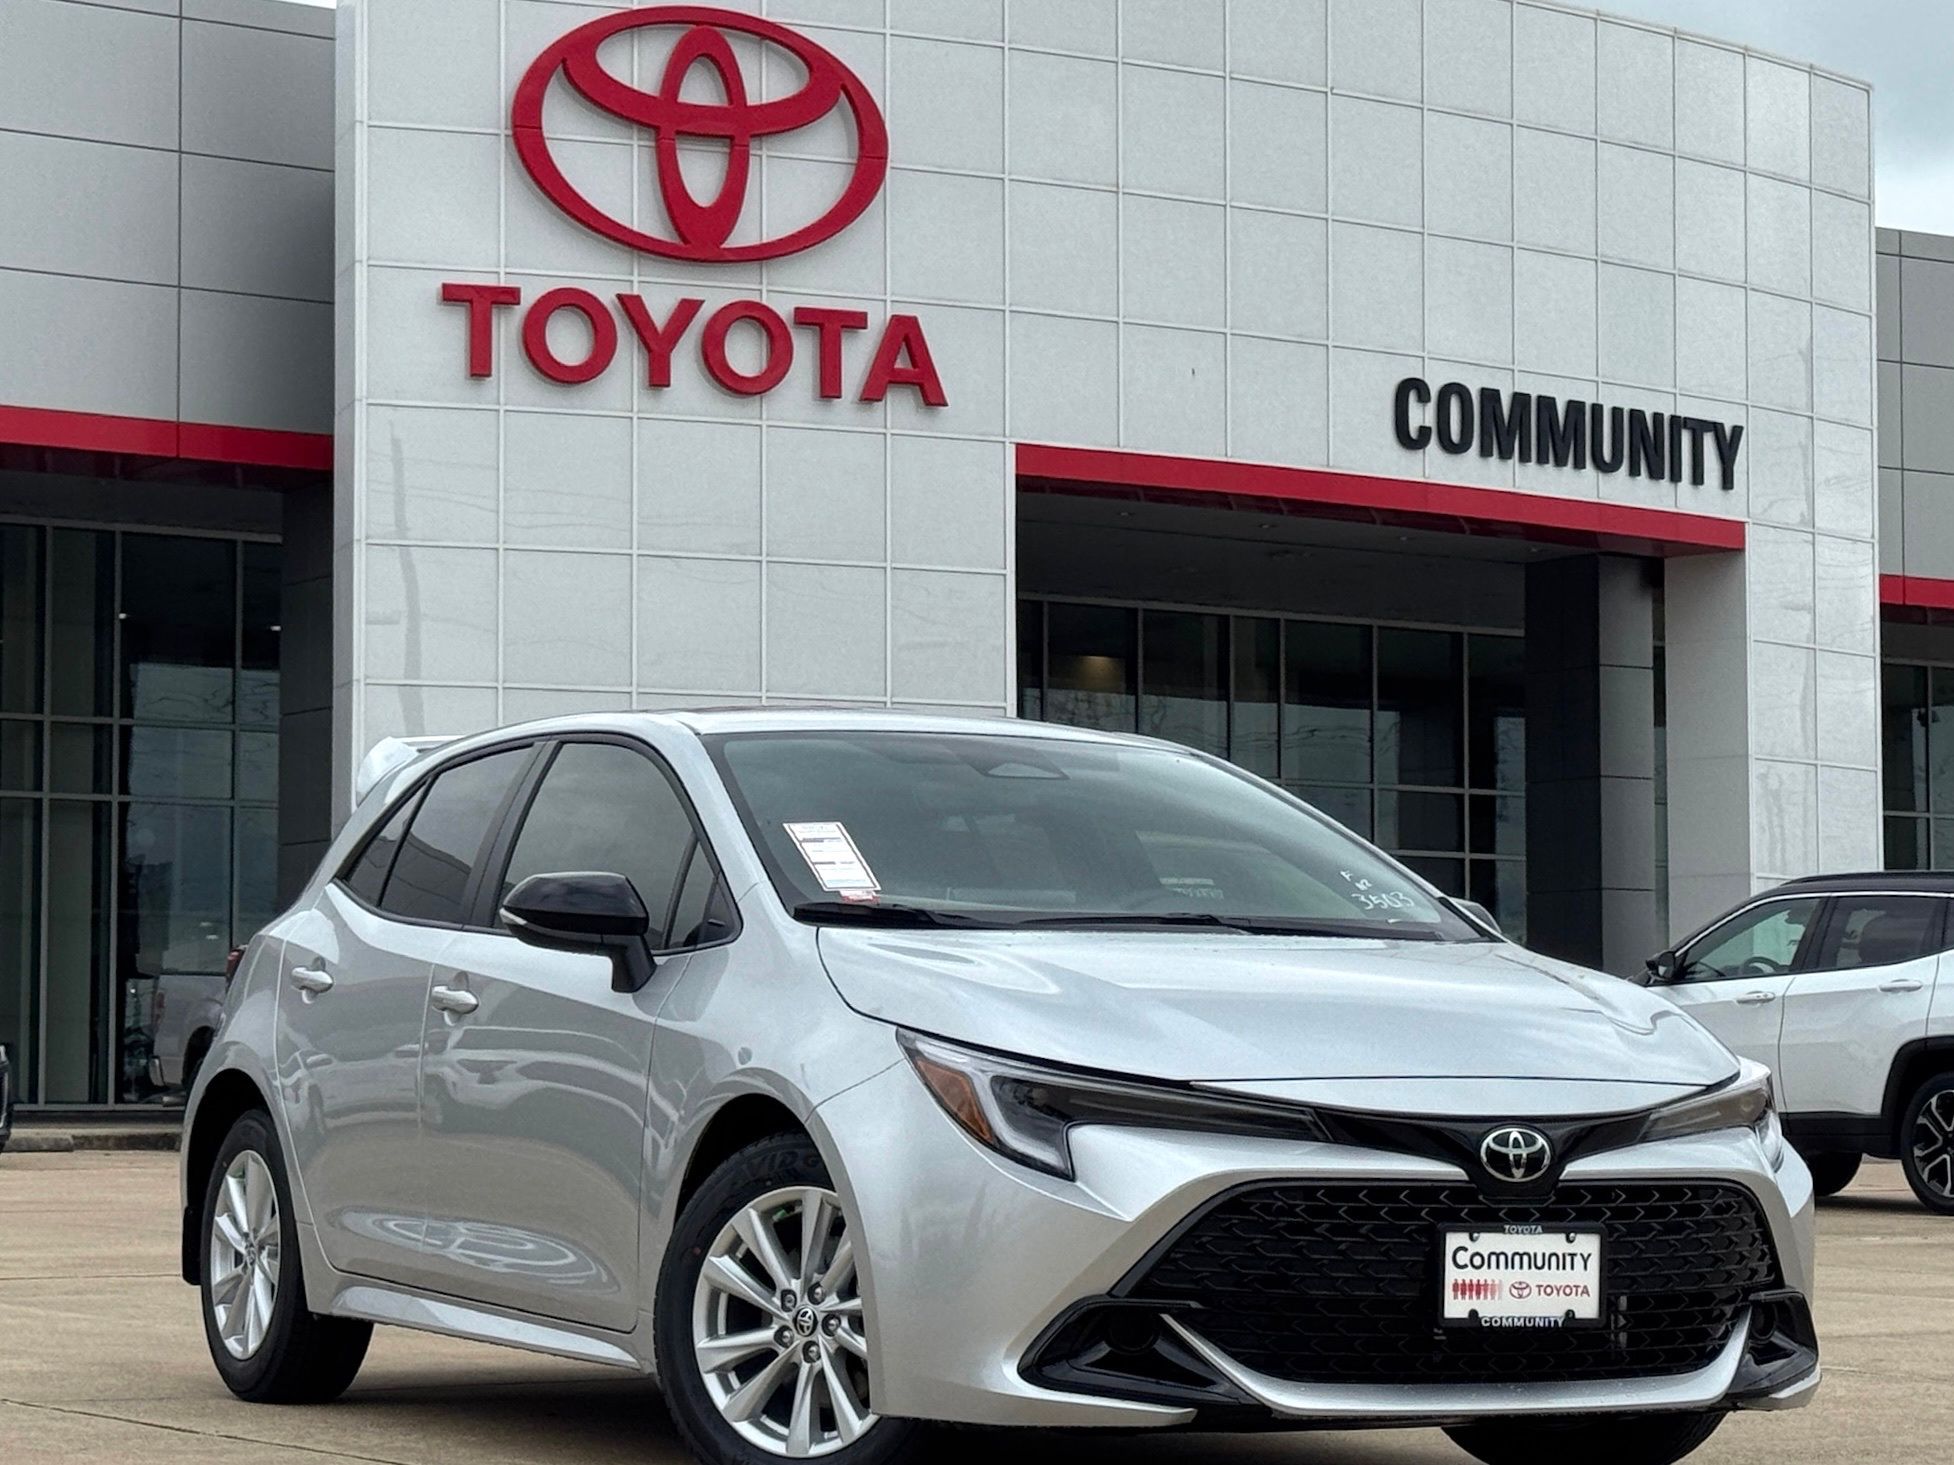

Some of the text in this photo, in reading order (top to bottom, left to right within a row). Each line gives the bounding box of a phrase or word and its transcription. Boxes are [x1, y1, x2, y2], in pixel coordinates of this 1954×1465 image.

[442, 282, 949, 407] TOYOTA
[1394, 377, 1744, 490] COMMUNITY
[1351, 891, 1414, 910] 3503
[1503, 1225, 1543, 1234] TOYOTA
[1535, 1284, 1591, 1297] TOYOTA
[1481, 1317, 1565, 1327] COMMUNITY
